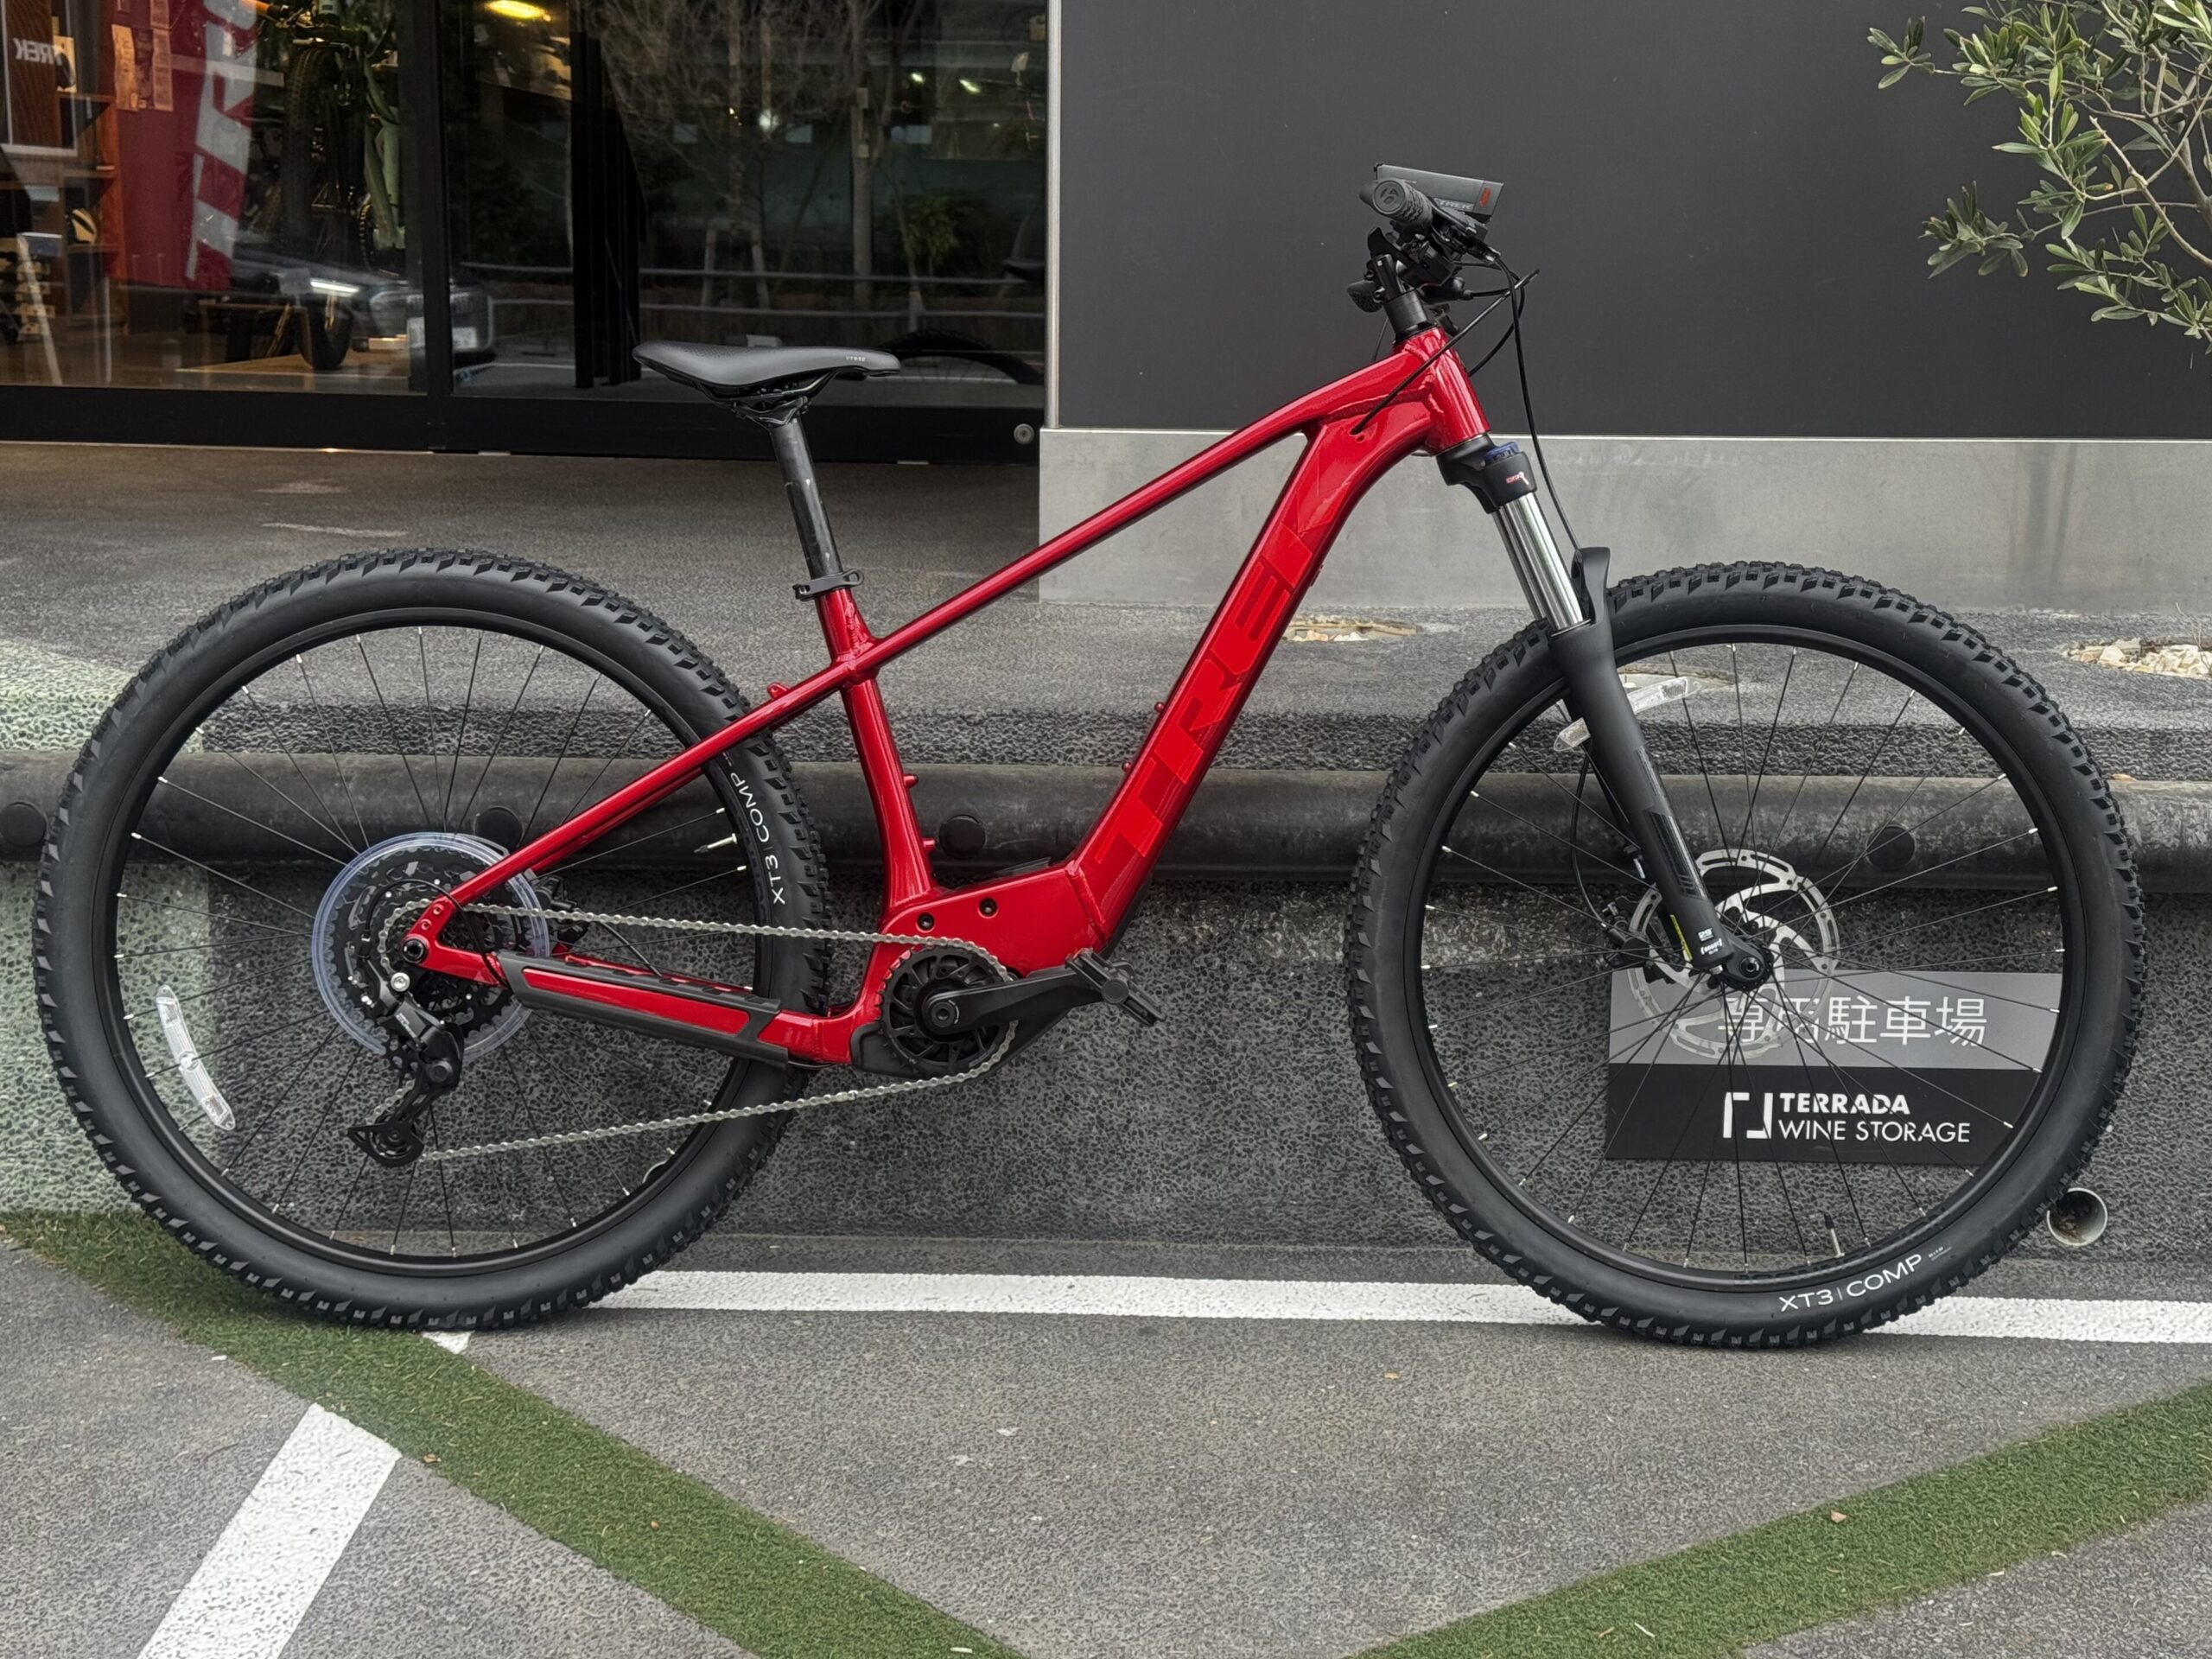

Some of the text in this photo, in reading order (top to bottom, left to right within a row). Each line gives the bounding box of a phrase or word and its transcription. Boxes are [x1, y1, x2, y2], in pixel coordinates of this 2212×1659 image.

[1095, 451, 1351, 864] TREK
[730, 772, 786, 906] XT3 COMP
[1778, 1119, 1971, 1143] WINE STORAGE
[1779, 1092, 1911, 1116] TERRADA
[1778, 1288, 1834, 1313] XT3
[1846, 1253, 1923, 1298] COMP
